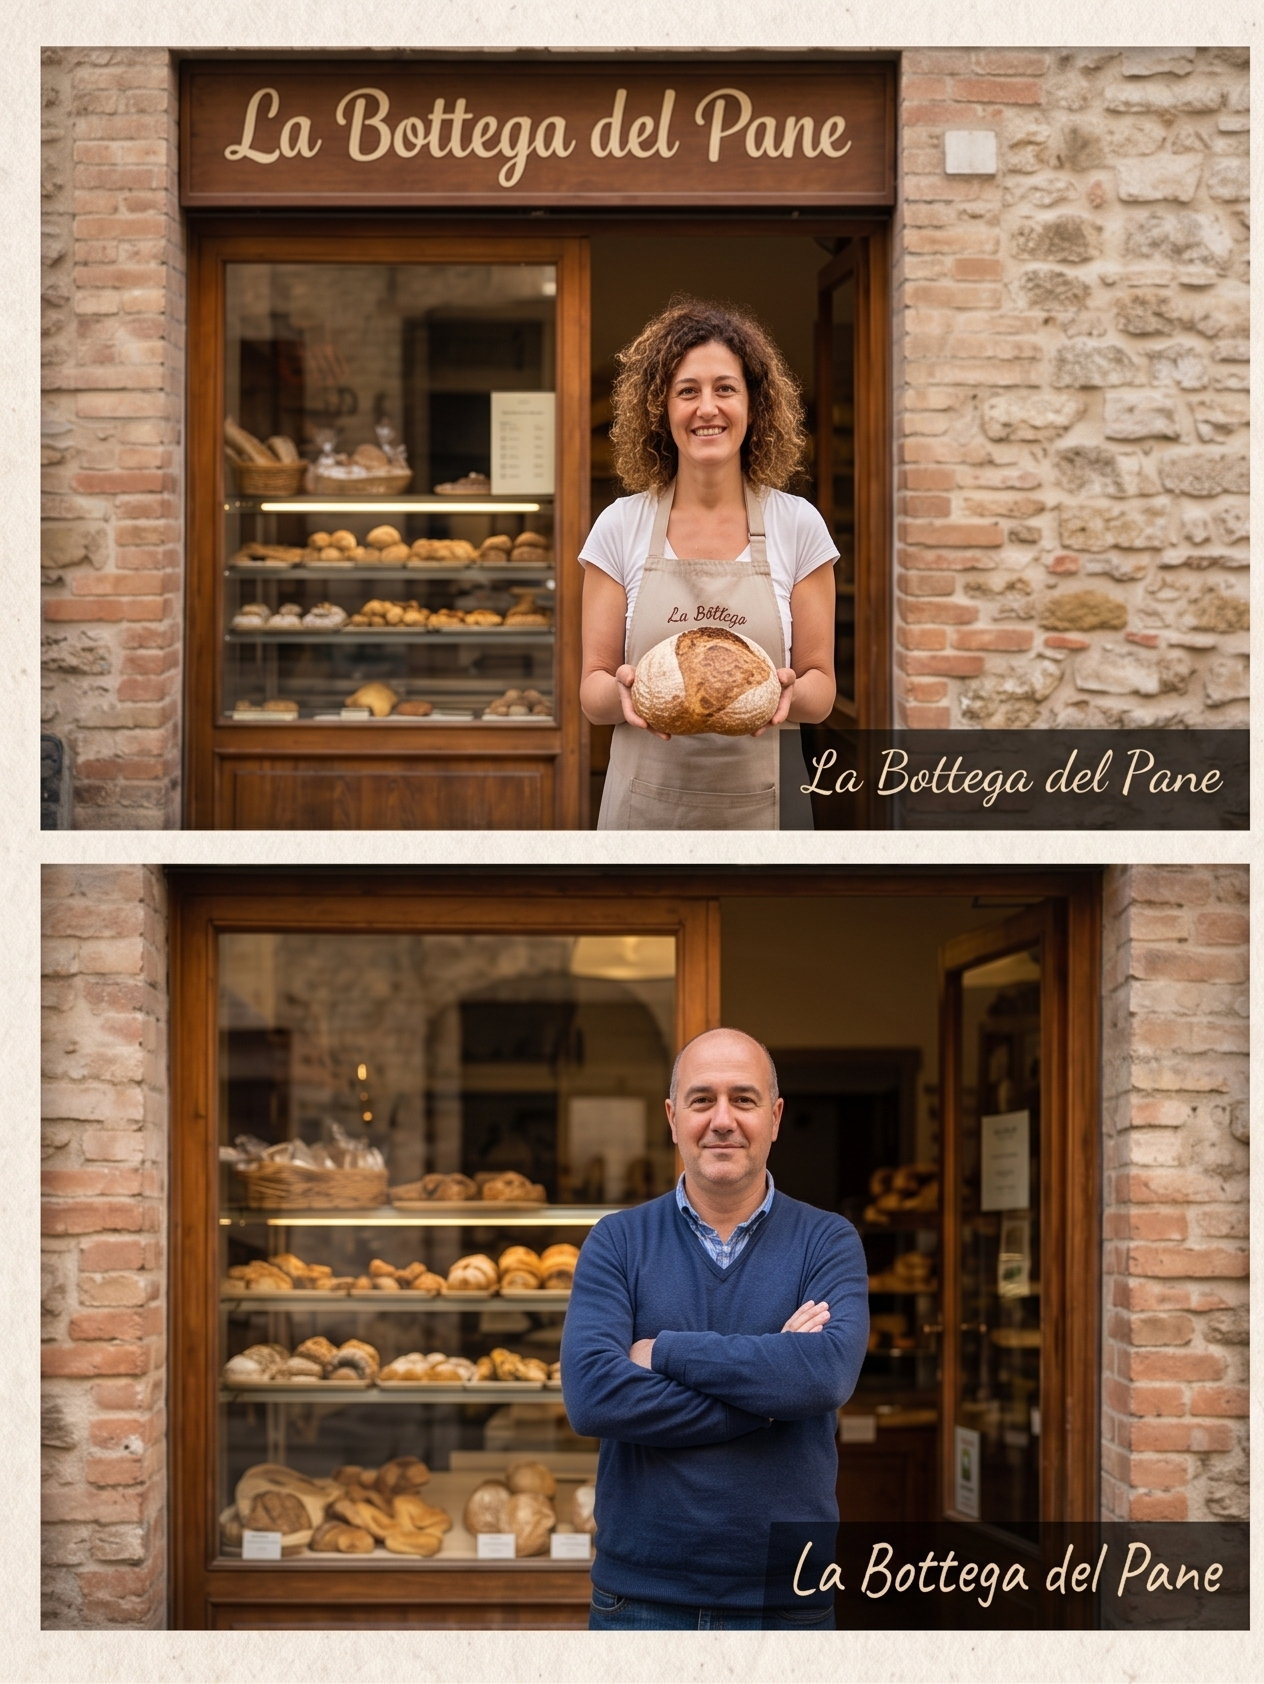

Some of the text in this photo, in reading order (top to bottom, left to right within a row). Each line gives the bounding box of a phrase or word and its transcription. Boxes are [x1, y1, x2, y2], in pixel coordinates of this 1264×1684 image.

[224, 88, 852, 188] La Bottega del Pane
[667, 606, 689, 623] La
